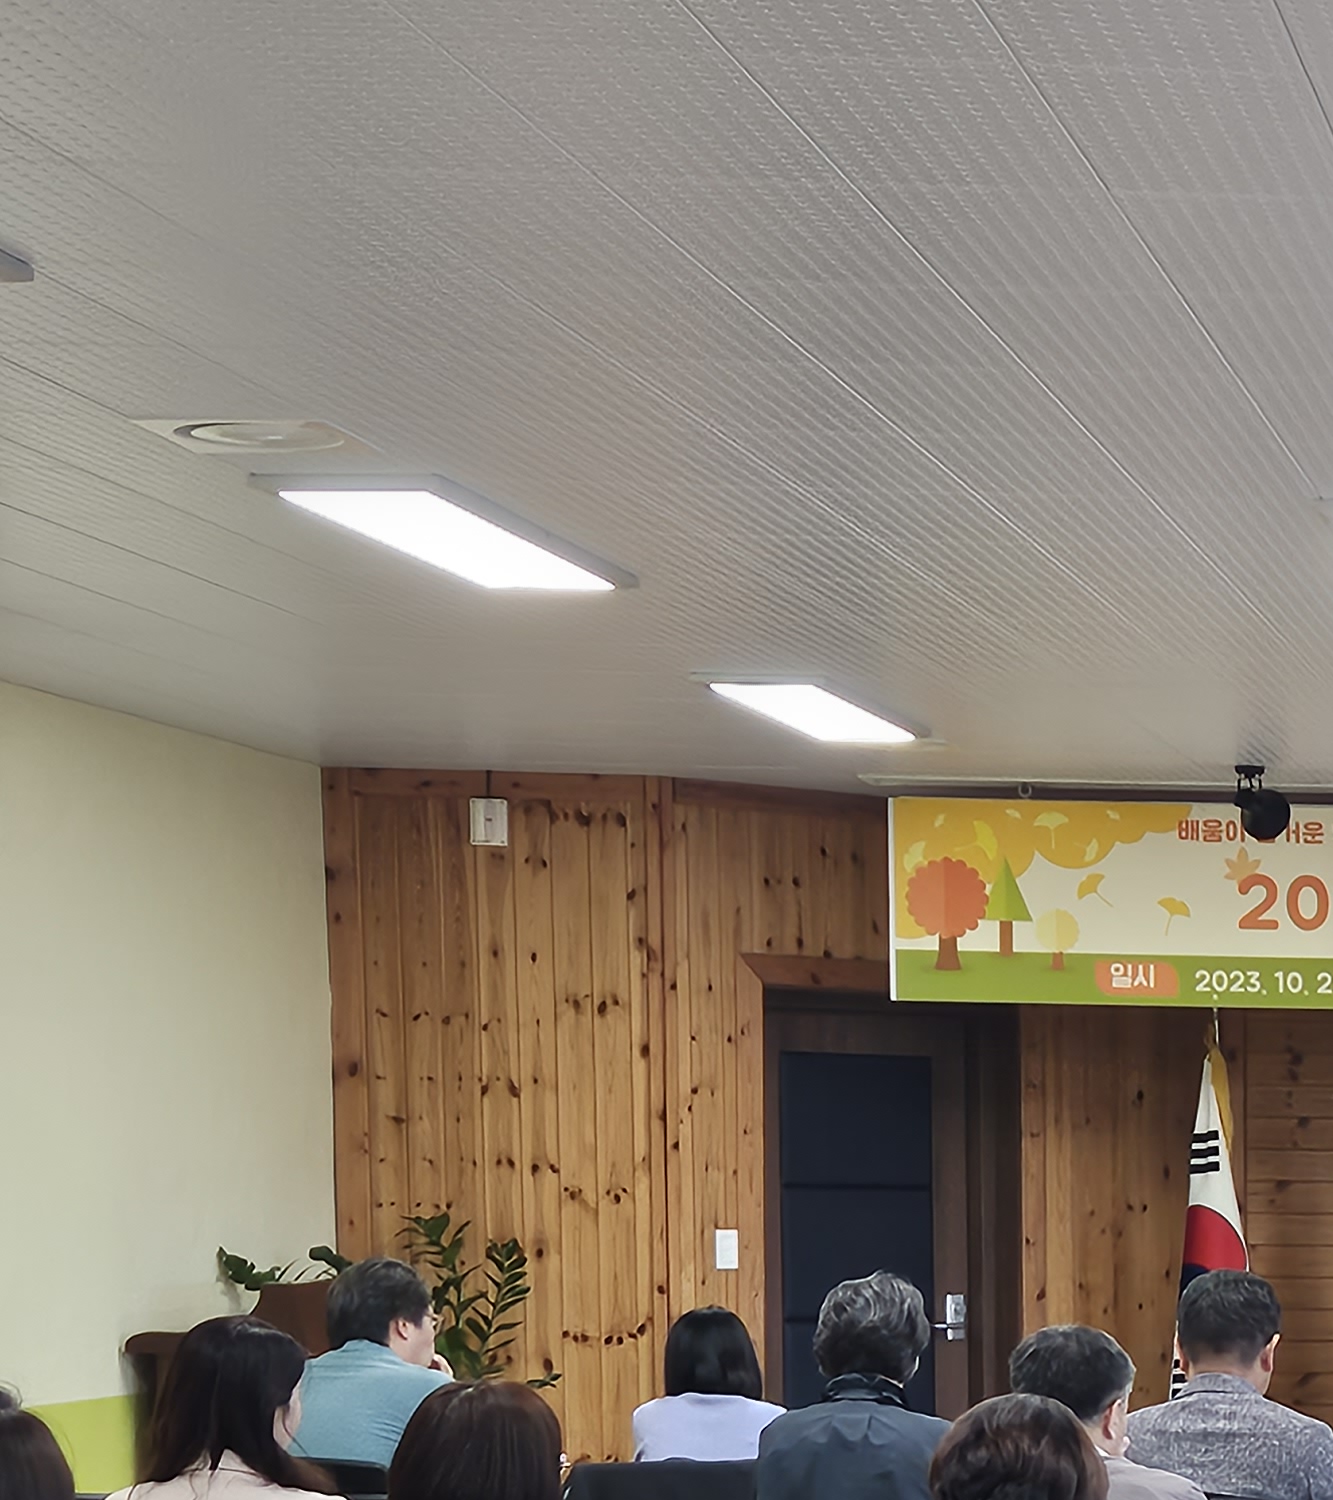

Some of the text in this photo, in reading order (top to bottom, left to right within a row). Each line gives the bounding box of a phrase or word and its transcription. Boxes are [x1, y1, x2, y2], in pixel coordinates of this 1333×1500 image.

[1177, 819, 1245, 843] 배움이
[1109, 963, 1156, 989] 일시
[1194, 970, 1268, 995] 2023.
